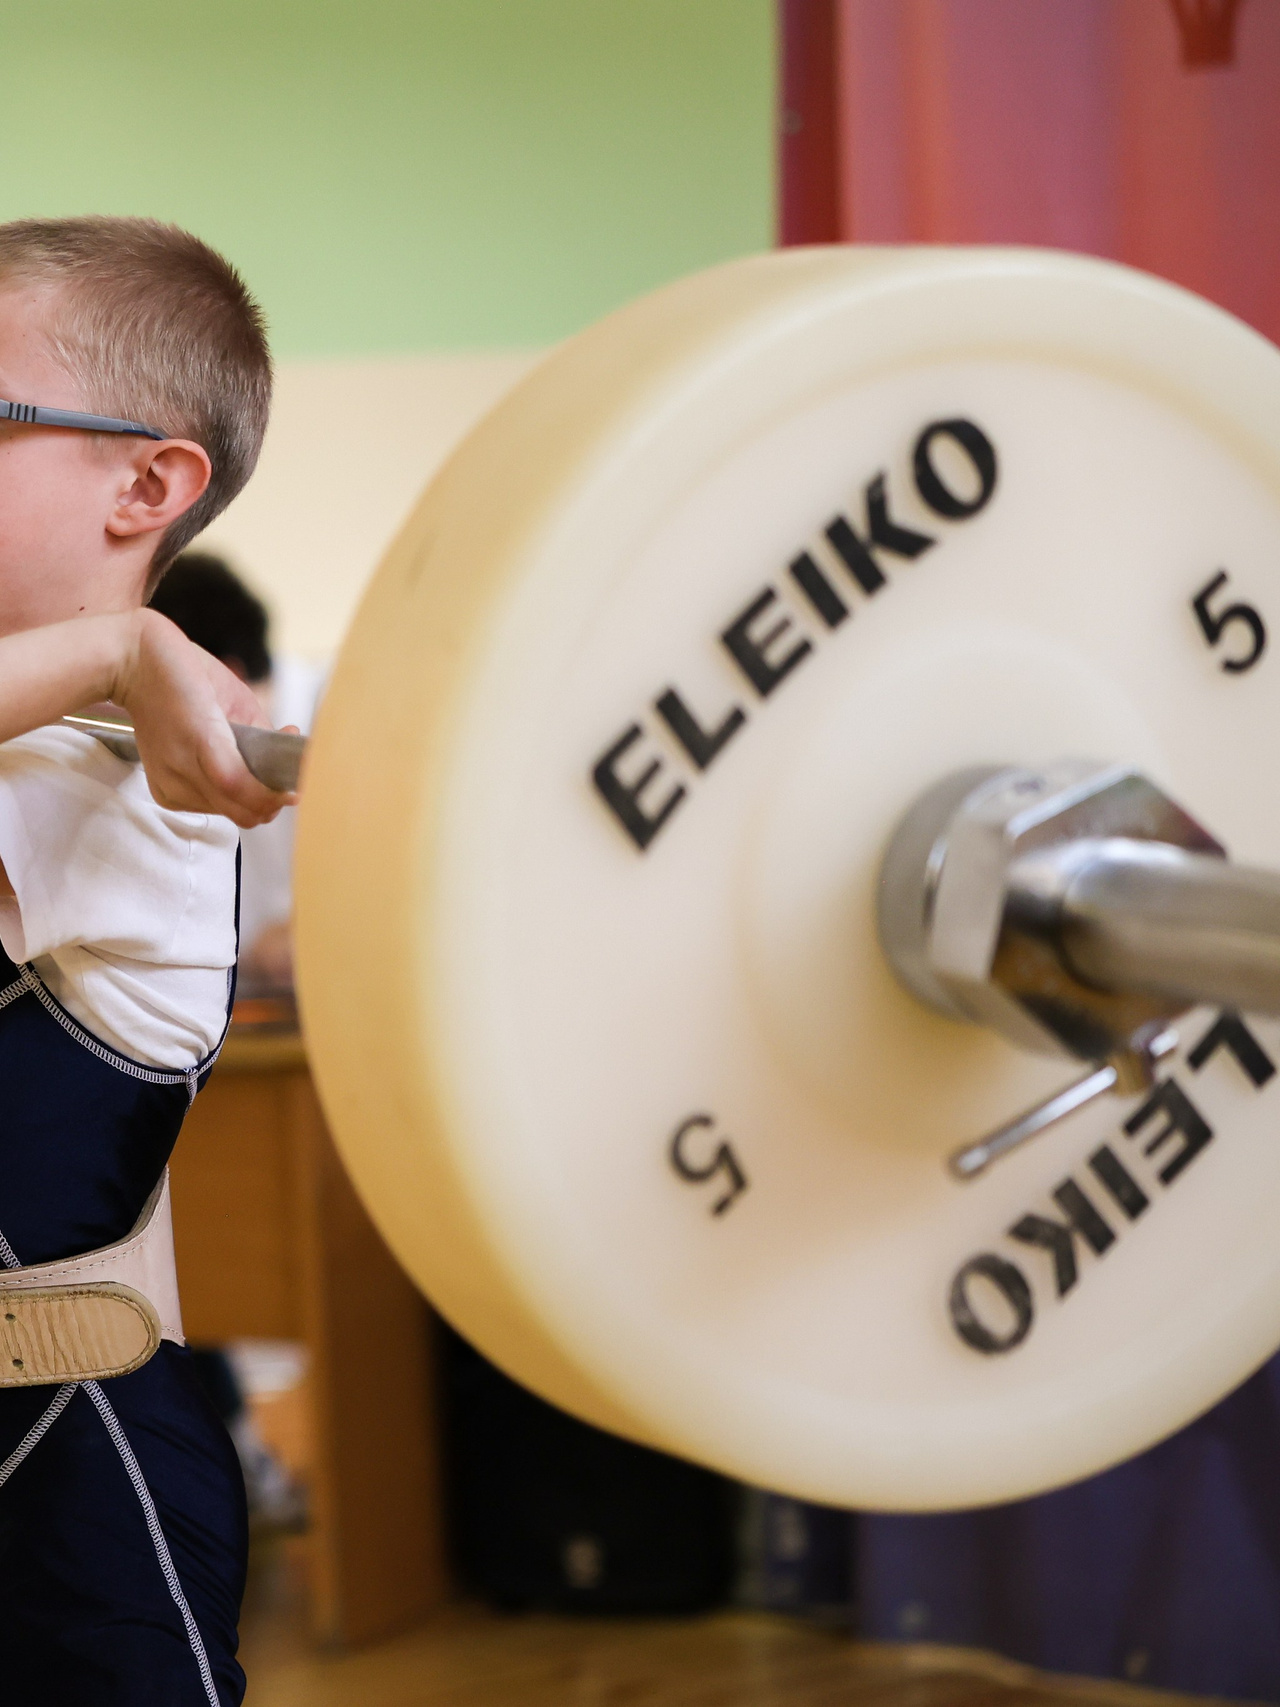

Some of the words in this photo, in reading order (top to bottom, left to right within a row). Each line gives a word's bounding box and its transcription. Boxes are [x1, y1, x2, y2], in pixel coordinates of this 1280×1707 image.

[589, 416, 1000, 853] ELEIKO
[1190, 569, 1268, 676] 5
[668, 1113, 750, 1218] 5
[948, 1004, 1278, 1357] LEIKO
